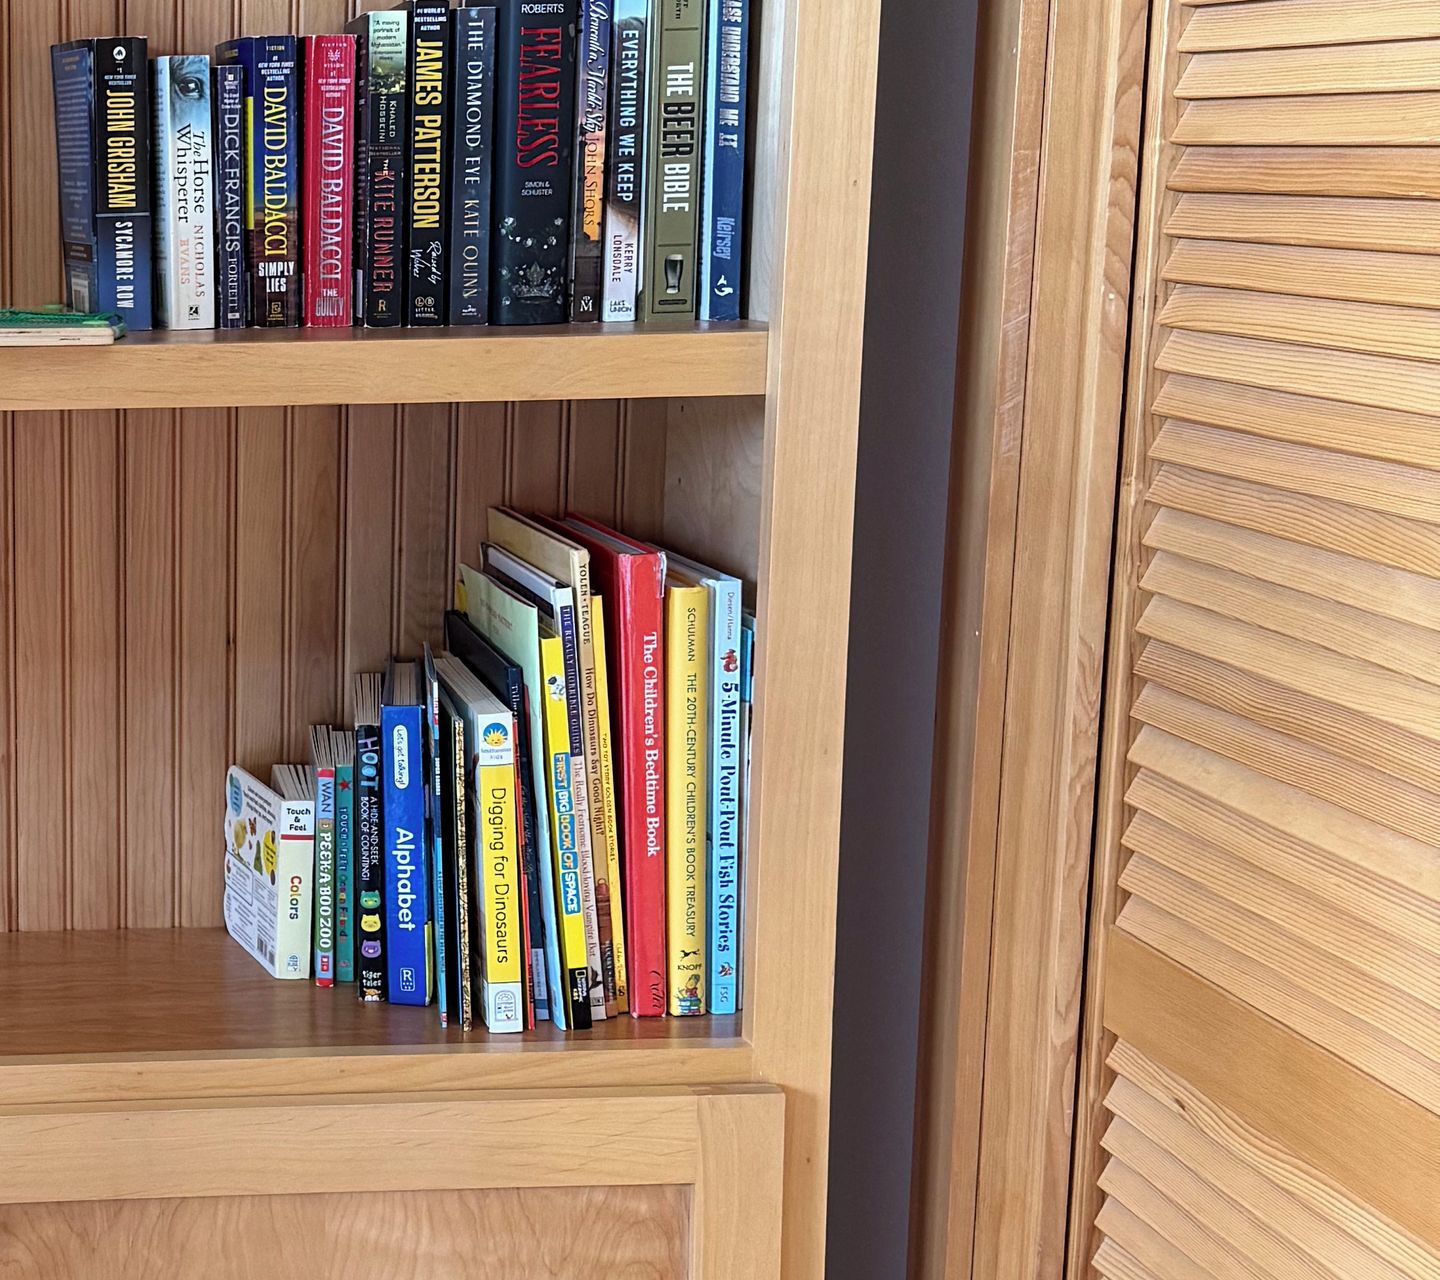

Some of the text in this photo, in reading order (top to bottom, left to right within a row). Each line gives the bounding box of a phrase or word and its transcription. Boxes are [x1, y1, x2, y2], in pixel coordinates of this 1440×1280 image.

[521, 3, 564, 14] ROBERTS
[582, 0, 608, 133] Beneath Marble Sky
[720, 26, 742, 103] UNDERSTAND
[106, 89, 135, 132] JOHN
[389, 100, 397, 138] KHALED
[464, 20, 484, 185] THE DIAMOND EYE
[515, 26, 562, 168] FEARLESS
[617, 30, 638, 202] EVERYTHING WE KEEP
[719, 108, 739, 127] ME
[321, 106, 345, 171] DAVID
[413, 39, 443, 229] JAMES PATTERSON
[661, 61, 696, 213] THE BEER BIBLE
[107, 137, 136, 208] GRISHAM
[174, 123, 192, 223] Whisperer
[193, 131, 209, 214] The Horse
[224, 114, 241, 252] DICK FRANCIS
[264, 87, 288, 257] DAVID BALDACCI
[373, 170, 395, 212] KITE
[584, 136, 599, 226] JOHN SHORS
[319, 177, 344, 280] BALDACCI
[463, 199, 480, 238] KATE
[713, 217, 735, 260] Keirsey
[115, 221, 135, 308] SYCAMORE ROW
[180, 238, 191, 285] EVANS
[194, 224, 205, 298] NICHOLAS
[227, 258, 238, 309] FORFEIT
[258, 261, 295, 277] SIMPLY
[266, 277, 287, 293] LIES
[372, 216, 395, 293] RUNNER
[462, 245, 479, 299] QUINN
[611, 234, 622, 283] LONSDALE
[624, 242, 634, 274] KERRY
[315, 297, 344, 317] GUILTY
[321, 288, 339, 297] THE
[579, 563, 591, 645] YOLEN TEAGUE
[687, 607, 696, 662] SCHULMAN
[358, 737, 380, 790] HOOT
[585, 667, 605, 836] How Do Dinosaurs Say Good Night?
[643, 632, 661, 857] The Children's Bedtime Book
[286, 807, 311, 816] Touch
[289, 823, 307, 832] Feel
[321, 781, 332, 813] WAN
[686, 673, 697, 937] THE 20TH-CENTURY CHILDREN'S BOOK TREASURY
[717, 681, 739, 952] 5-Minute Pout-Pout Fish Stories
[361, 797, 370, 881] BOOK OF COUNTING!
[370, 803, 379, 865] HIDE-AND-SEEK
[555, 754, 578, 913] FIRST BIG BOOK OF SPACE
[289, 875, 302, 920] Colors
[392, 827, 417, 931] Alphabet
[489, 787, 510, 964] Digging for Dinosaurs
[319, 918, 332, 948] ZOO
[362, 970, 382, 979] tiger
[362, 979, 382, 987] tales
[720, 986, 729, 1003] FSG
